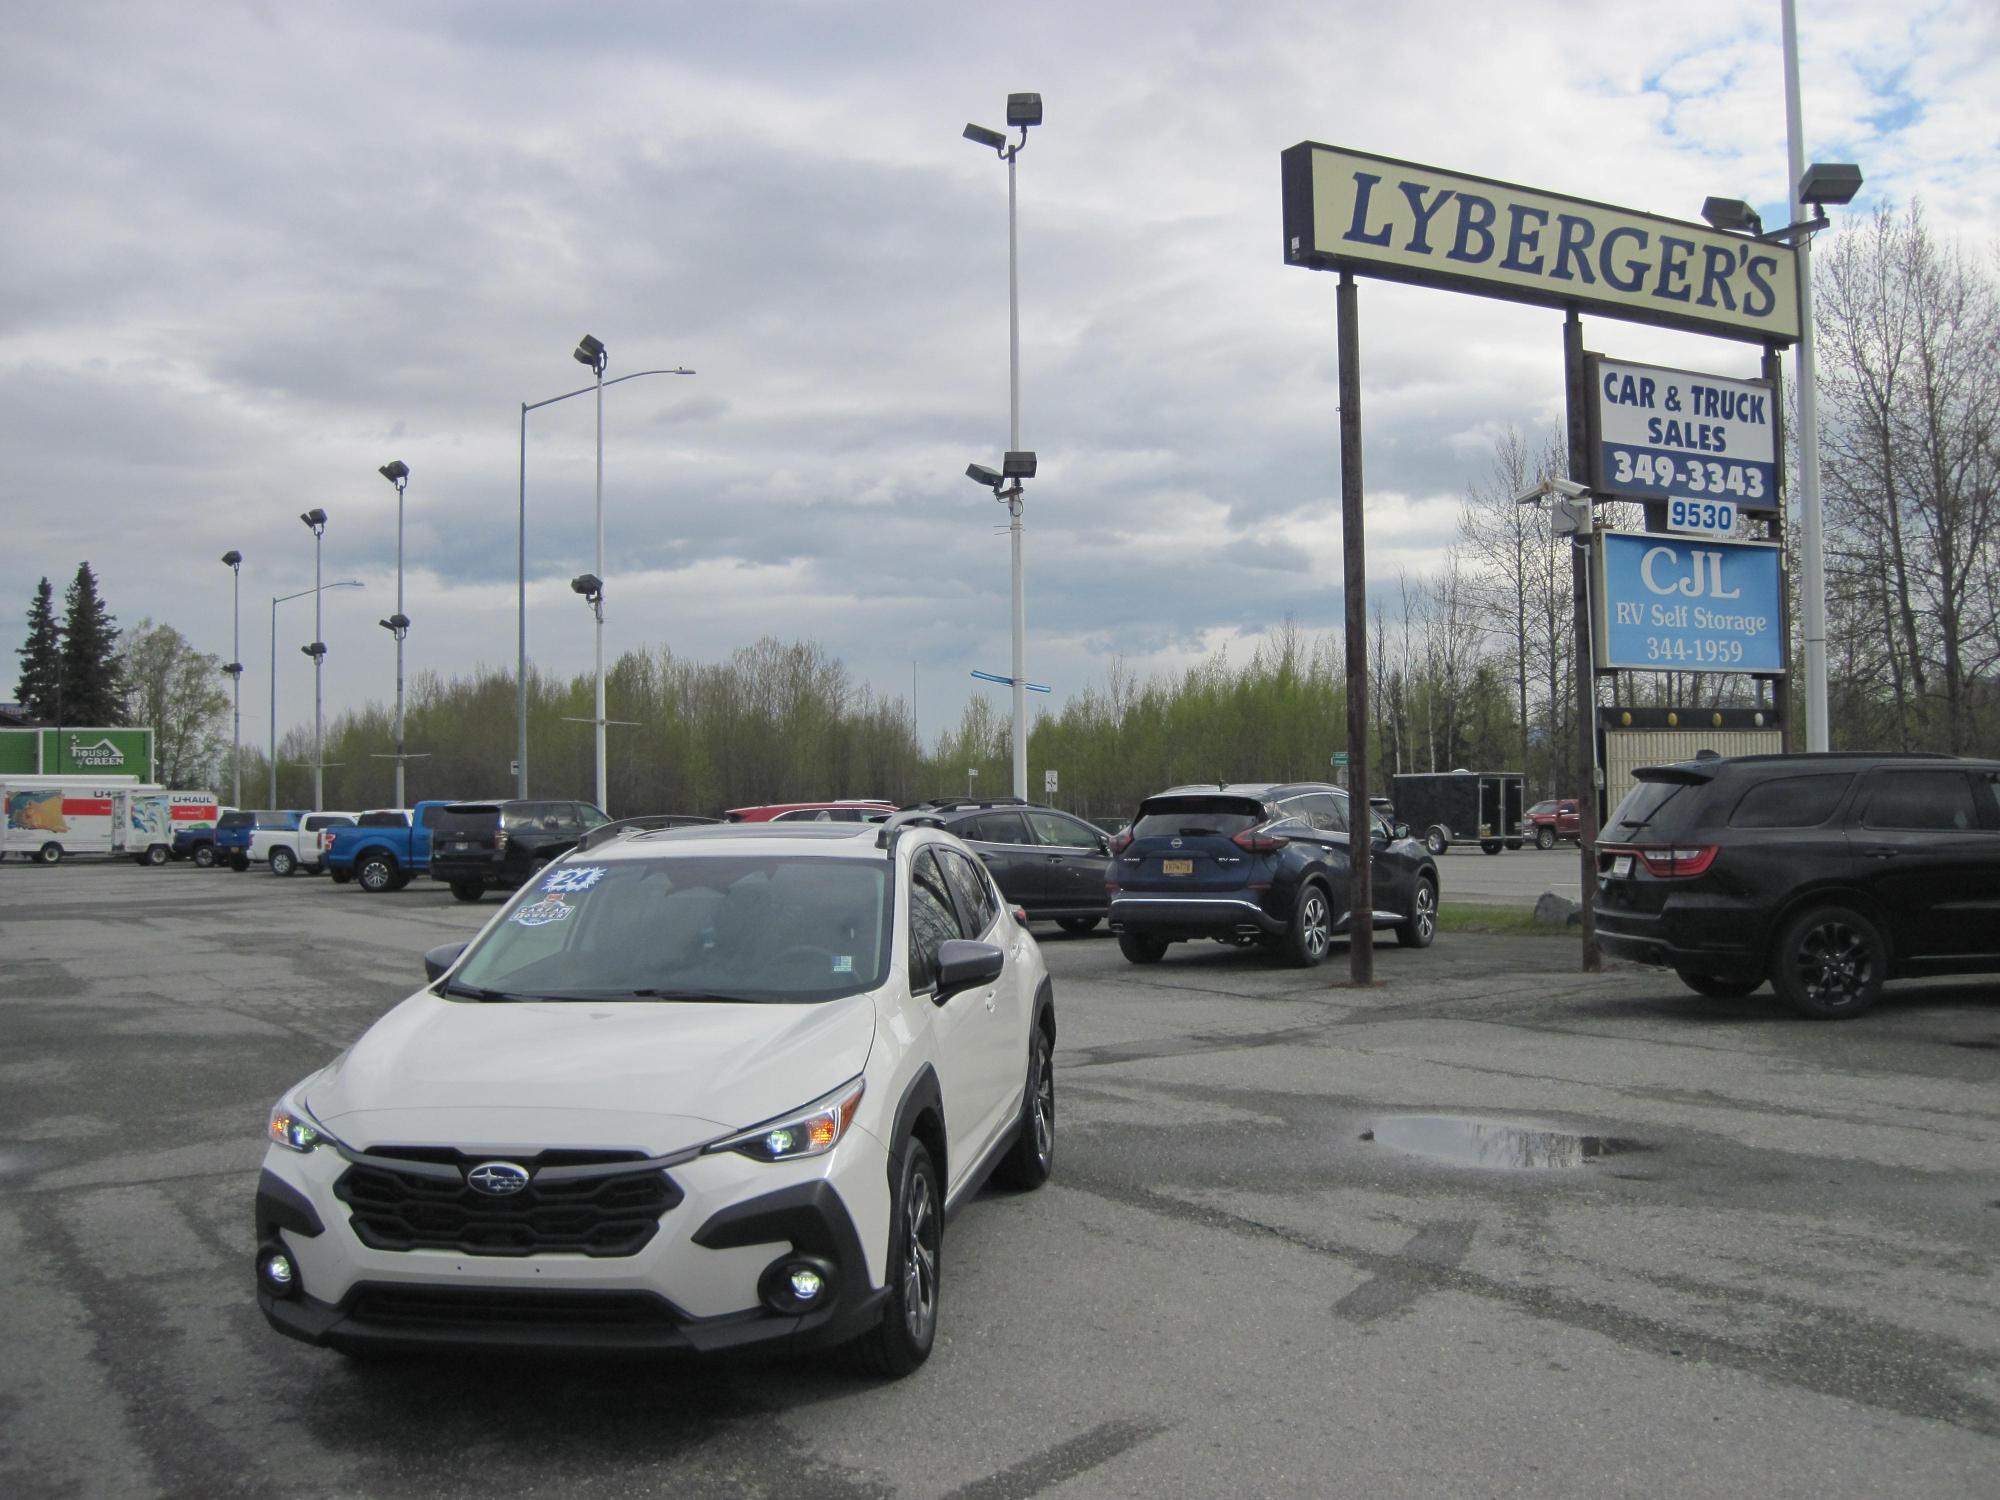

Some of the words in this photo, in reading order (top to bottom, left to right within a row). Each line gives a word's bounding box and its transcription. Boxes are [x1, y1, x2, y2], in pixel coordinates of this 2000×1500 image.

[1343, 172, 1777, 317] LYBERGER'S
[1604, 372, 1655, 408] CAR
[1665, 386, 1681, 412] &
[1691, 385, 1765, 424] TRUCK
[1648, 417, 1726, 452] SALES
[1613, 451, 1764, 497] 349-3343
[1672, 502, 1732, 530] 9530
[1641, 547, 1740, 599] CJL
[1616, 602, 1645, 625] RV
[1651, 604, 1688, 628] Self
[1694, 607, 1767, 636] Storage
[1647, 637, 1743, 663] 344-1959
[85, 757, 124, 766] GREEN
[553, 870, 593, 886] 24
